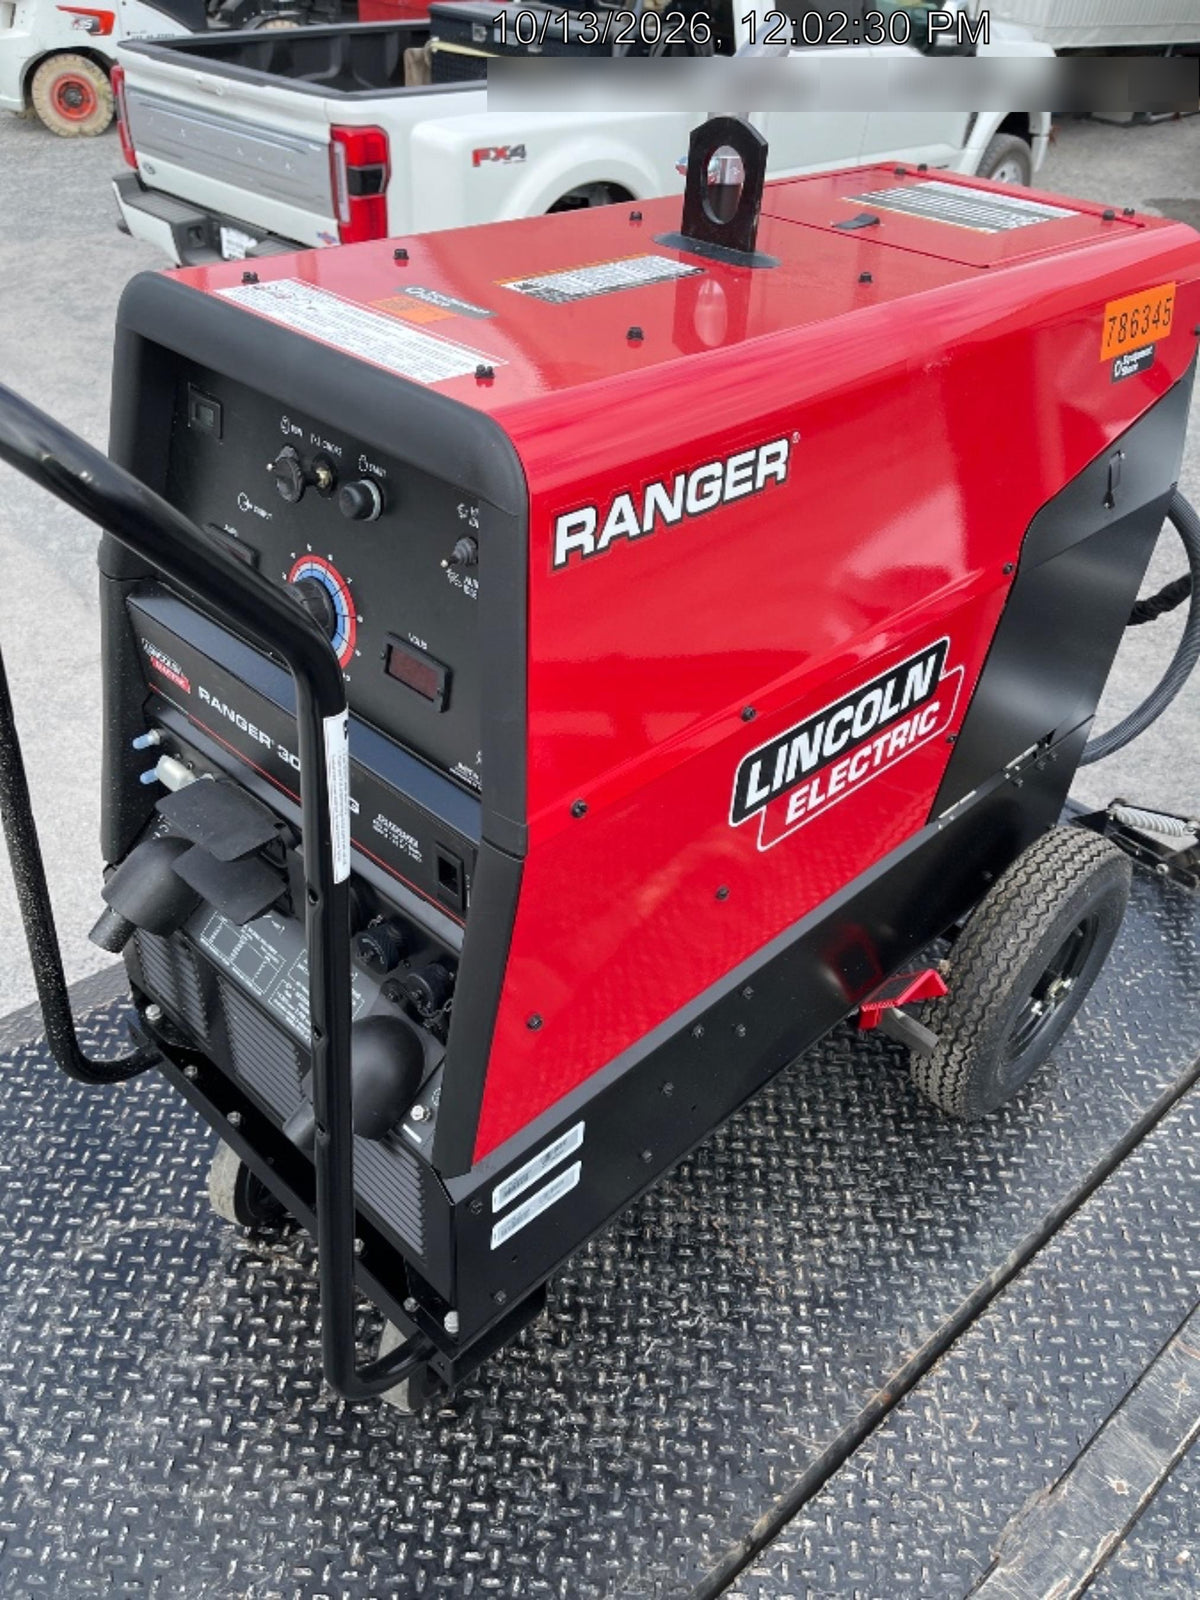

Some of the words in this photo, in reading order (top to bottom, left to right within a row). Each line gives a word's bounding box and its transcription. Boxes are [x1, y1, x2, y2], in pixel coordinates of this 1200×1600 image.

[472, 144, 527, 167] FX4
[1107, 297, 1173, 348] 786345
[198, 685, 272, 749] RANGER
[277, 744, 301, 772] 30
[745, 653, 937, 809] LINCOLN
[785, 701, 940, 825] ELECTRIC
